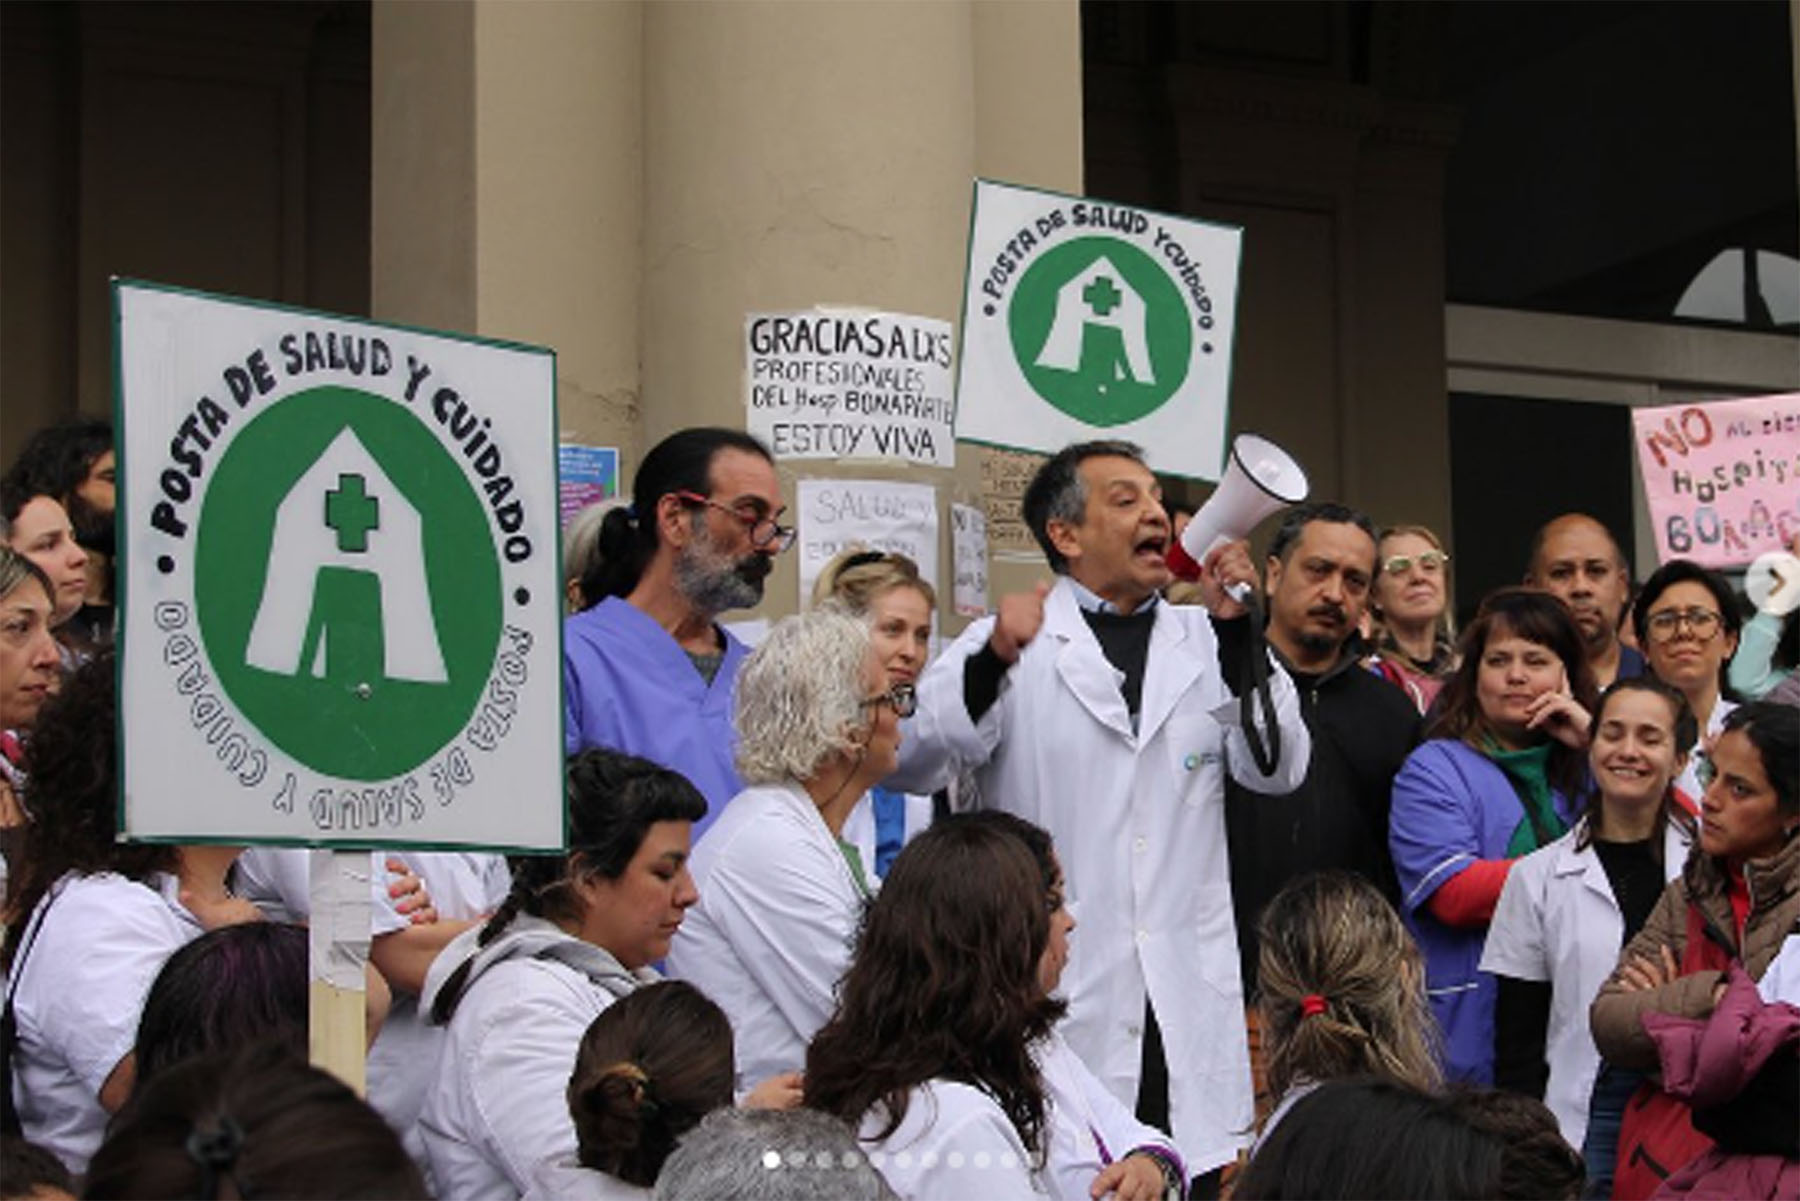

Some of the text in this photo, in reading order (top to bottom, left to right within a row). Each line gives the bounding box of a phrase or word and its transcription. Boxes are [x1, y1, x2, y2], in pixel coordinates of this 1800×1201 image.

[982, 229, 1037, 301] POSTA
[1036, 210, 1067, 238] DE
[1071, 204, 1149, 234] SALUD
[1154, 226, 1170, 248] Y
[751, 318, 884, 358] GRACIAS
[888, 325, 908, 360] A
[753, 359, 926, 393] PROFESIONALES
[752, 385, 789, 408] DEL
[845, 390, 955, 426] BONAPARTE
[151, 397, 230, 539] POSTA
[223, 349, 277, 408] DE
[279, 331, 392, 377] SALUD
[406, 355, 431, 403] Y
[772, 423, 937, 459] ESTOY VIVA
[1646, 407, 1714, 468] NO
[815, 489, 906, 524] SALUD
[153, 600, 535, 831] POSTA DE SALUD Y CUIDADO
